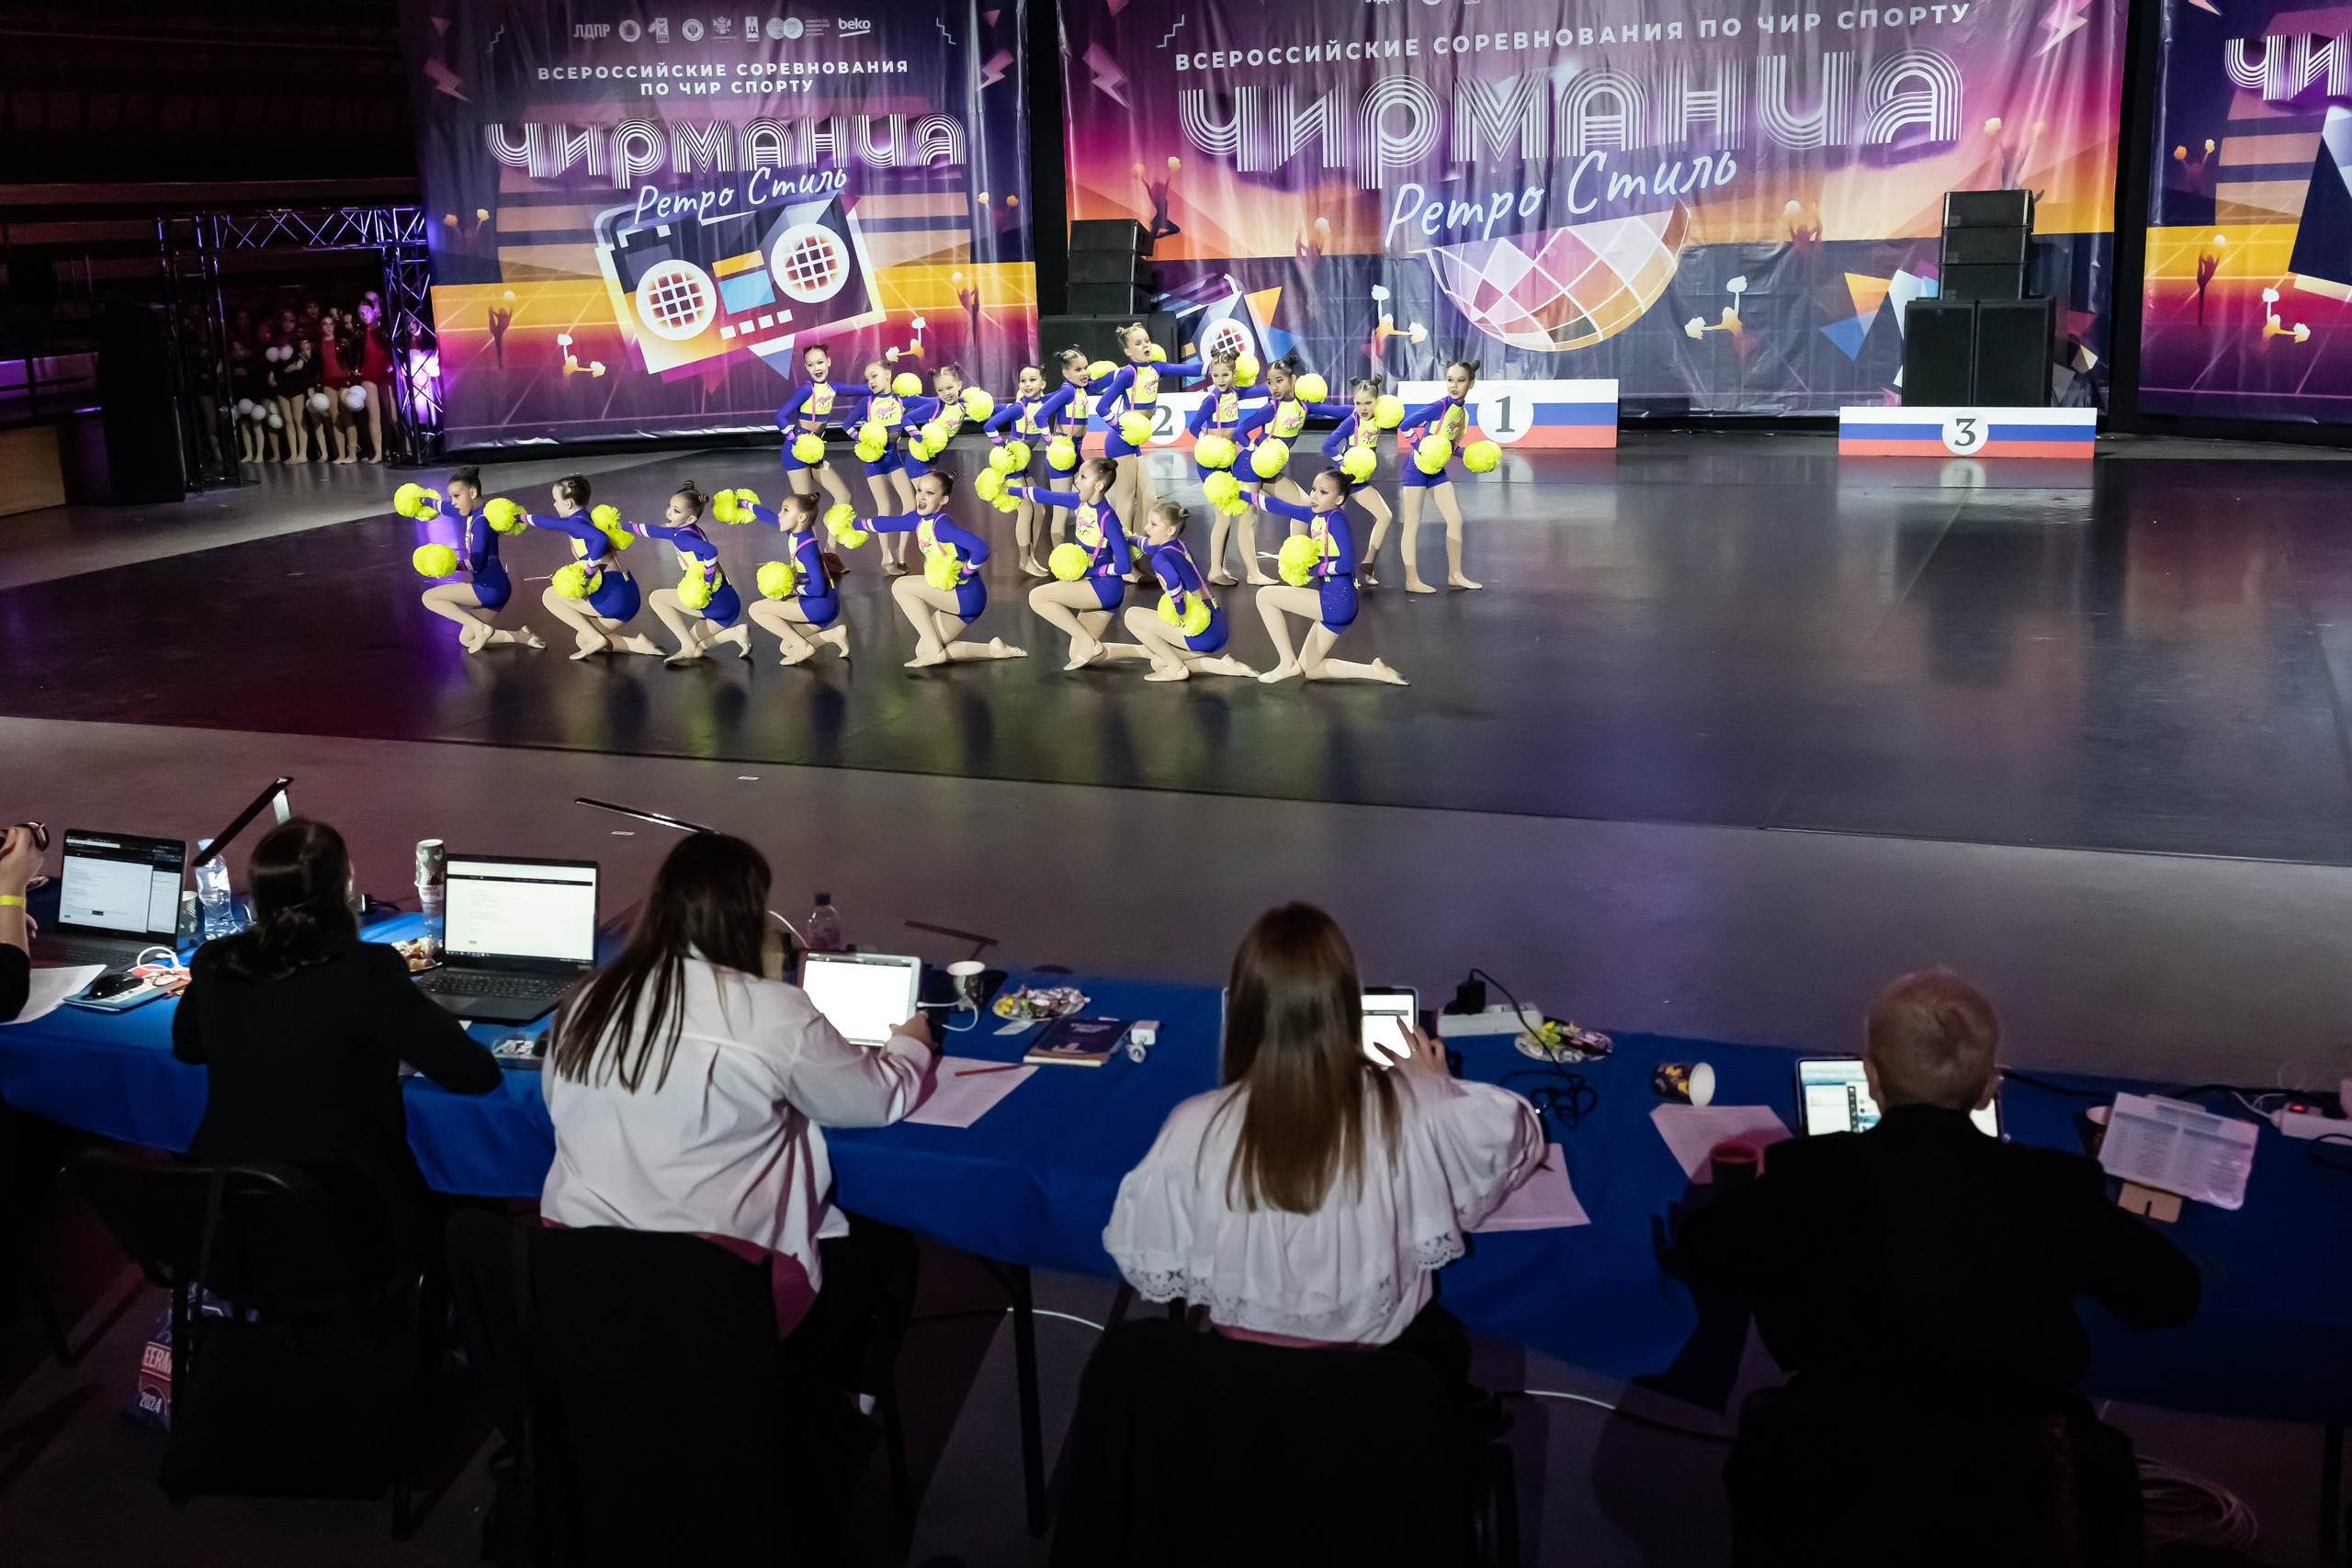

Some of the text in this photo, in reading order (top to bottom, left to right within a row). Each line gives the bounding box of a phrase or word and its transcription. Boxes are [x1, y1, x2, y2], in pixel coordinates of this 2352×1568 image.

[573, 24, 610, 39] ЛДПР
[838, 17, 871, 30] beko
[1176, 3, 1970, 71] ВСЕРОССИЙСКИЕ СОРЕВНОВАНИЯ ПО ЧИР СПОРТУ
[538, 61, 908, 81] ВСЕРОССИЙСКИЕ СОРЕВНОВАНИЯ
[640, 80, 813, 96] ПО ЧИР СПОРТУ
[634, 166, 847, 226] Ретро Стиль
[1385, 150, 1737, 247] Ретро Стиль
[1152, 405, 1173, 435] 2
[1496, 396, 1515, 432] 1
[1954, 418, 1976, 446] 3
[139, 1392, 163, 1415] 2024
